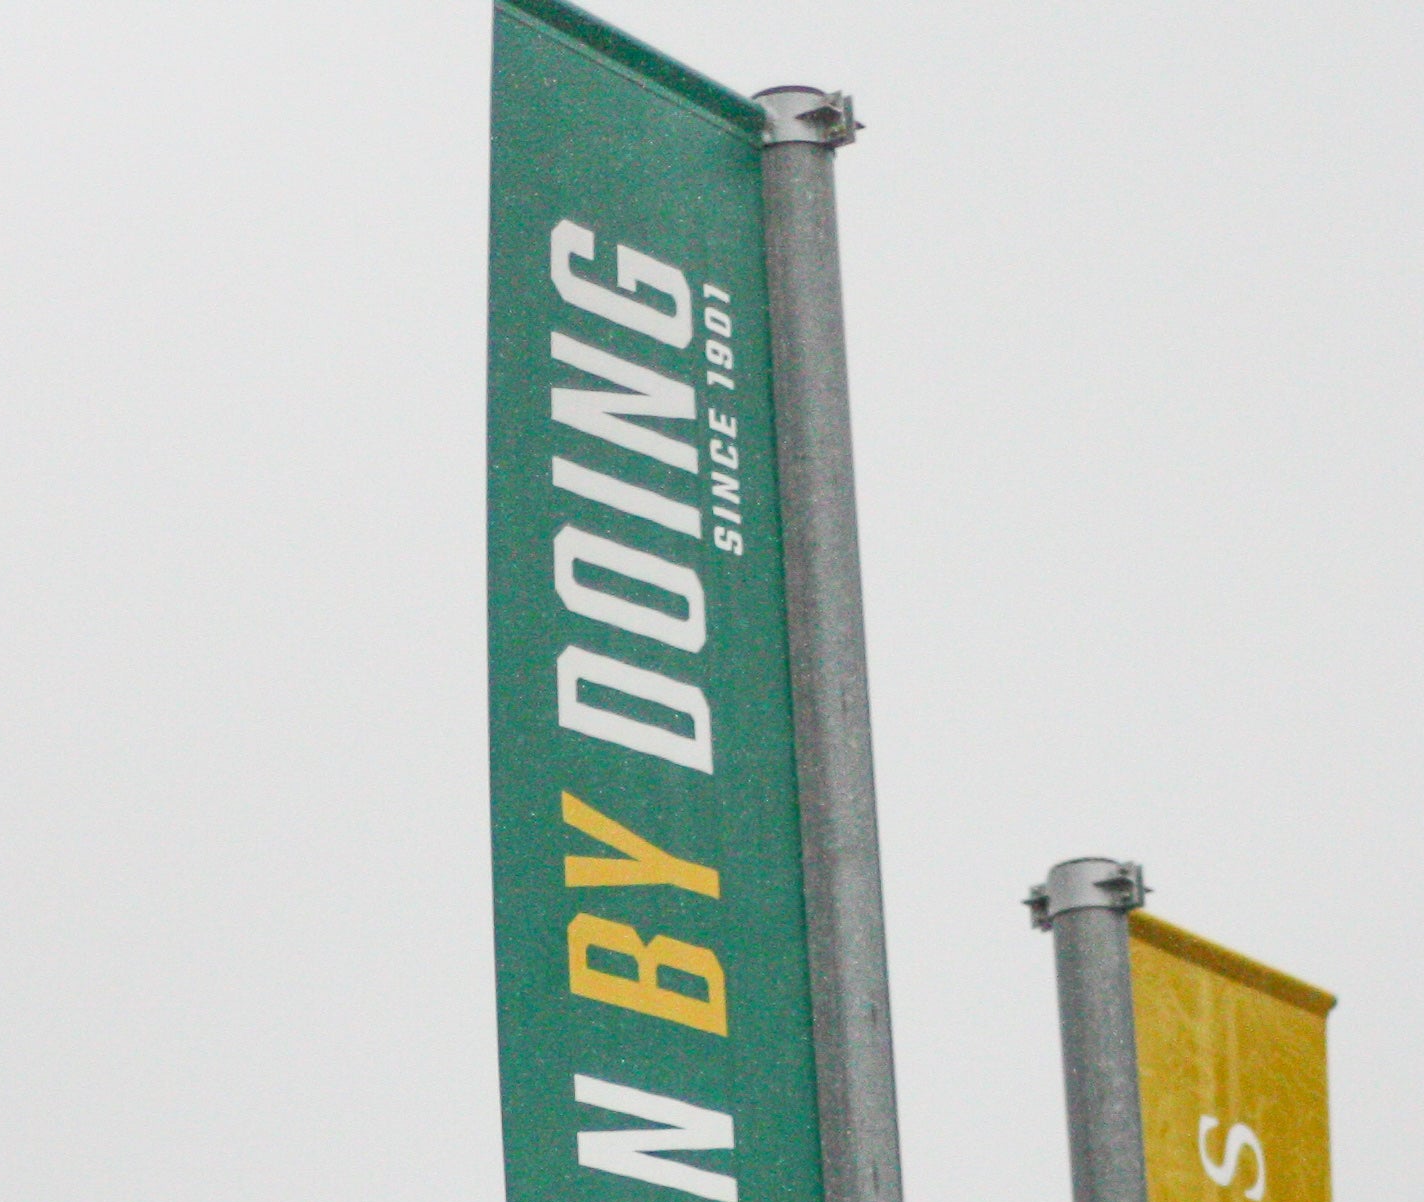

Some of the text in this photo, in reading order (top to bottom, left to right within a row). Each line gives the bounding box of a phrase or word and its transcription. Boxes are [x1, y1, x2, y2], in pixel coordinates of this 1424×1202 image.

[549, 218, 715, 775] DOING
[702, 282, 744, 557] SINCE 1901
[561, 790, 729, 1037] BY
